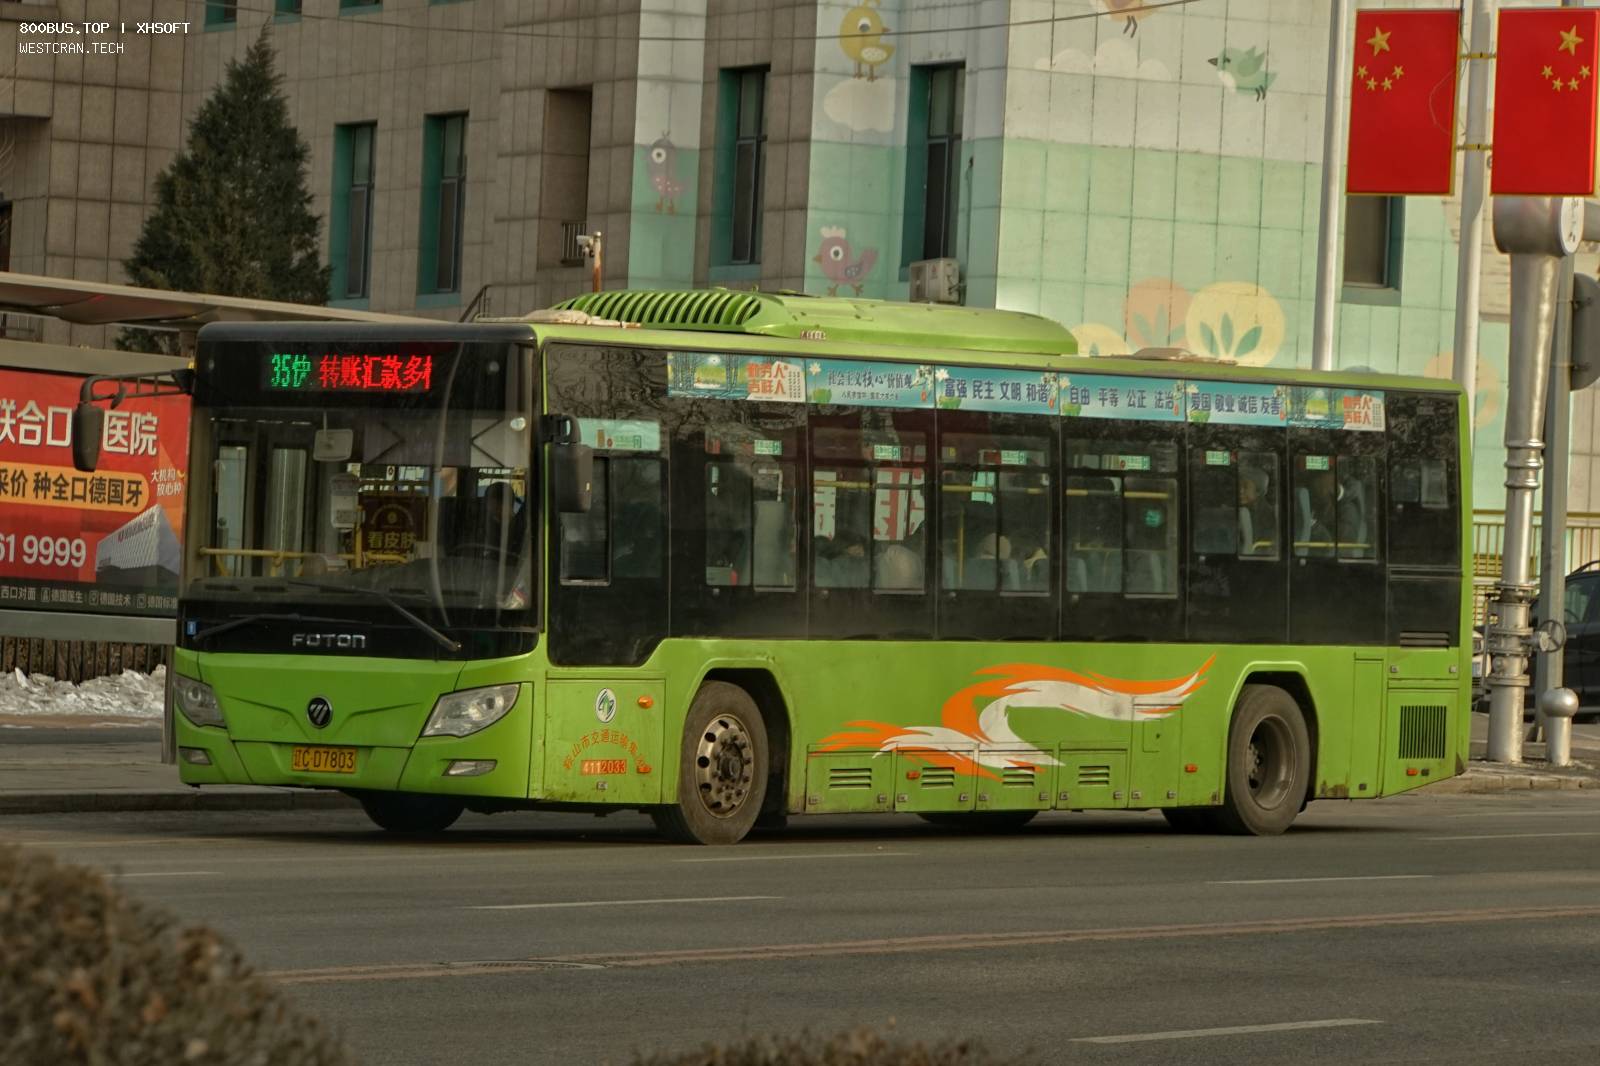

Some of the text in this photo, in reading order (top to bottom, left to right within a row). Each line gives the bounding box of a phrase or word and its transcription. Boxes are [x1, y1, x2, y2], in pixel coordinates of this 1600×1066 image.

[944, 378, 1049, 403] 富强 民主 文明 和谐
[1069, 385, 1174, 410] 自由 平等 公正 法治
[1190, 392, 1281, 416] 爱国 敬业 诚信 友善
[0, 398, 159, 456] 联合口医院
[33, 472, 142, 507] 种全口德国牙
[22, 535, 87, 568] 9999
